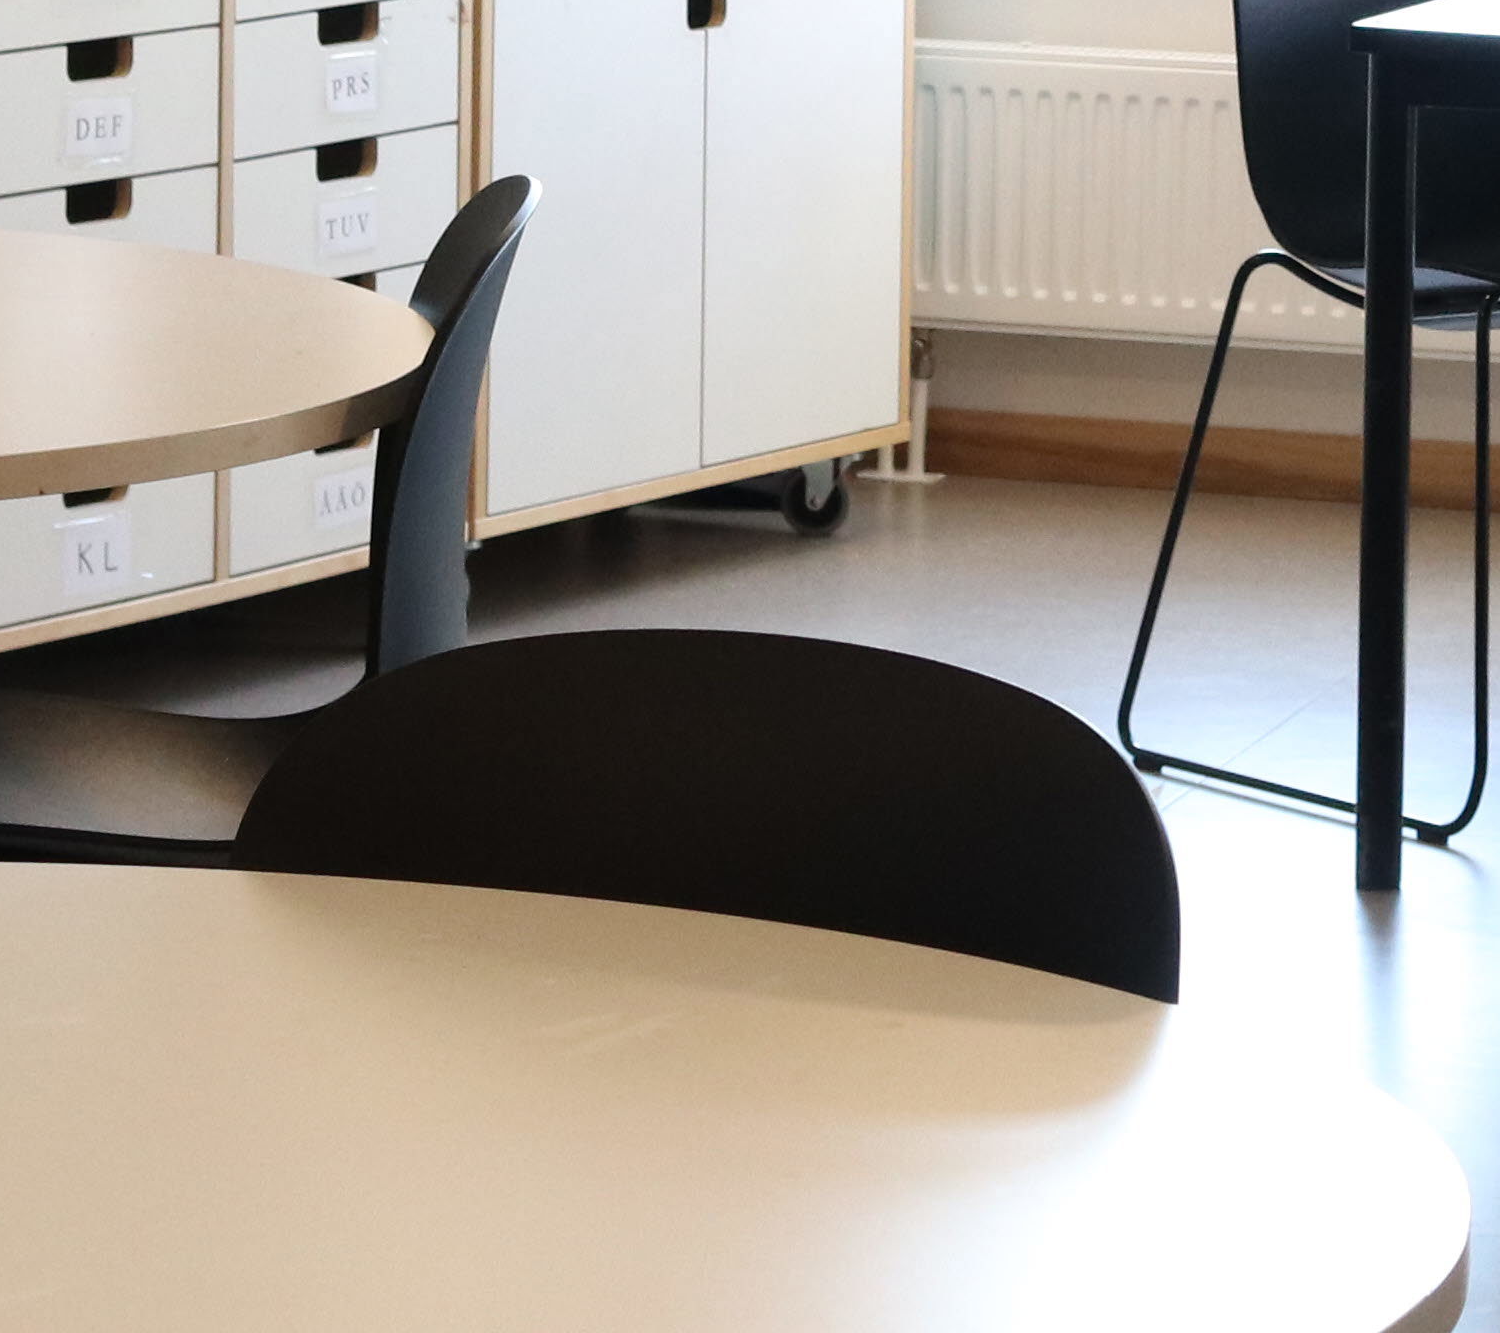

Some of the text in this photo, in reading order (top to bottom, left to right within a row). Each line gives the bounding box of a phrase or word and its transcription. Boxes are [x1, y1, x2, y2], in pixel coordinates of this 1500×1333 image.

[331, 71, 371, 101] PRS
[75, 114, 123, 142] DEF
[325, 212, 370, 240] TUV
